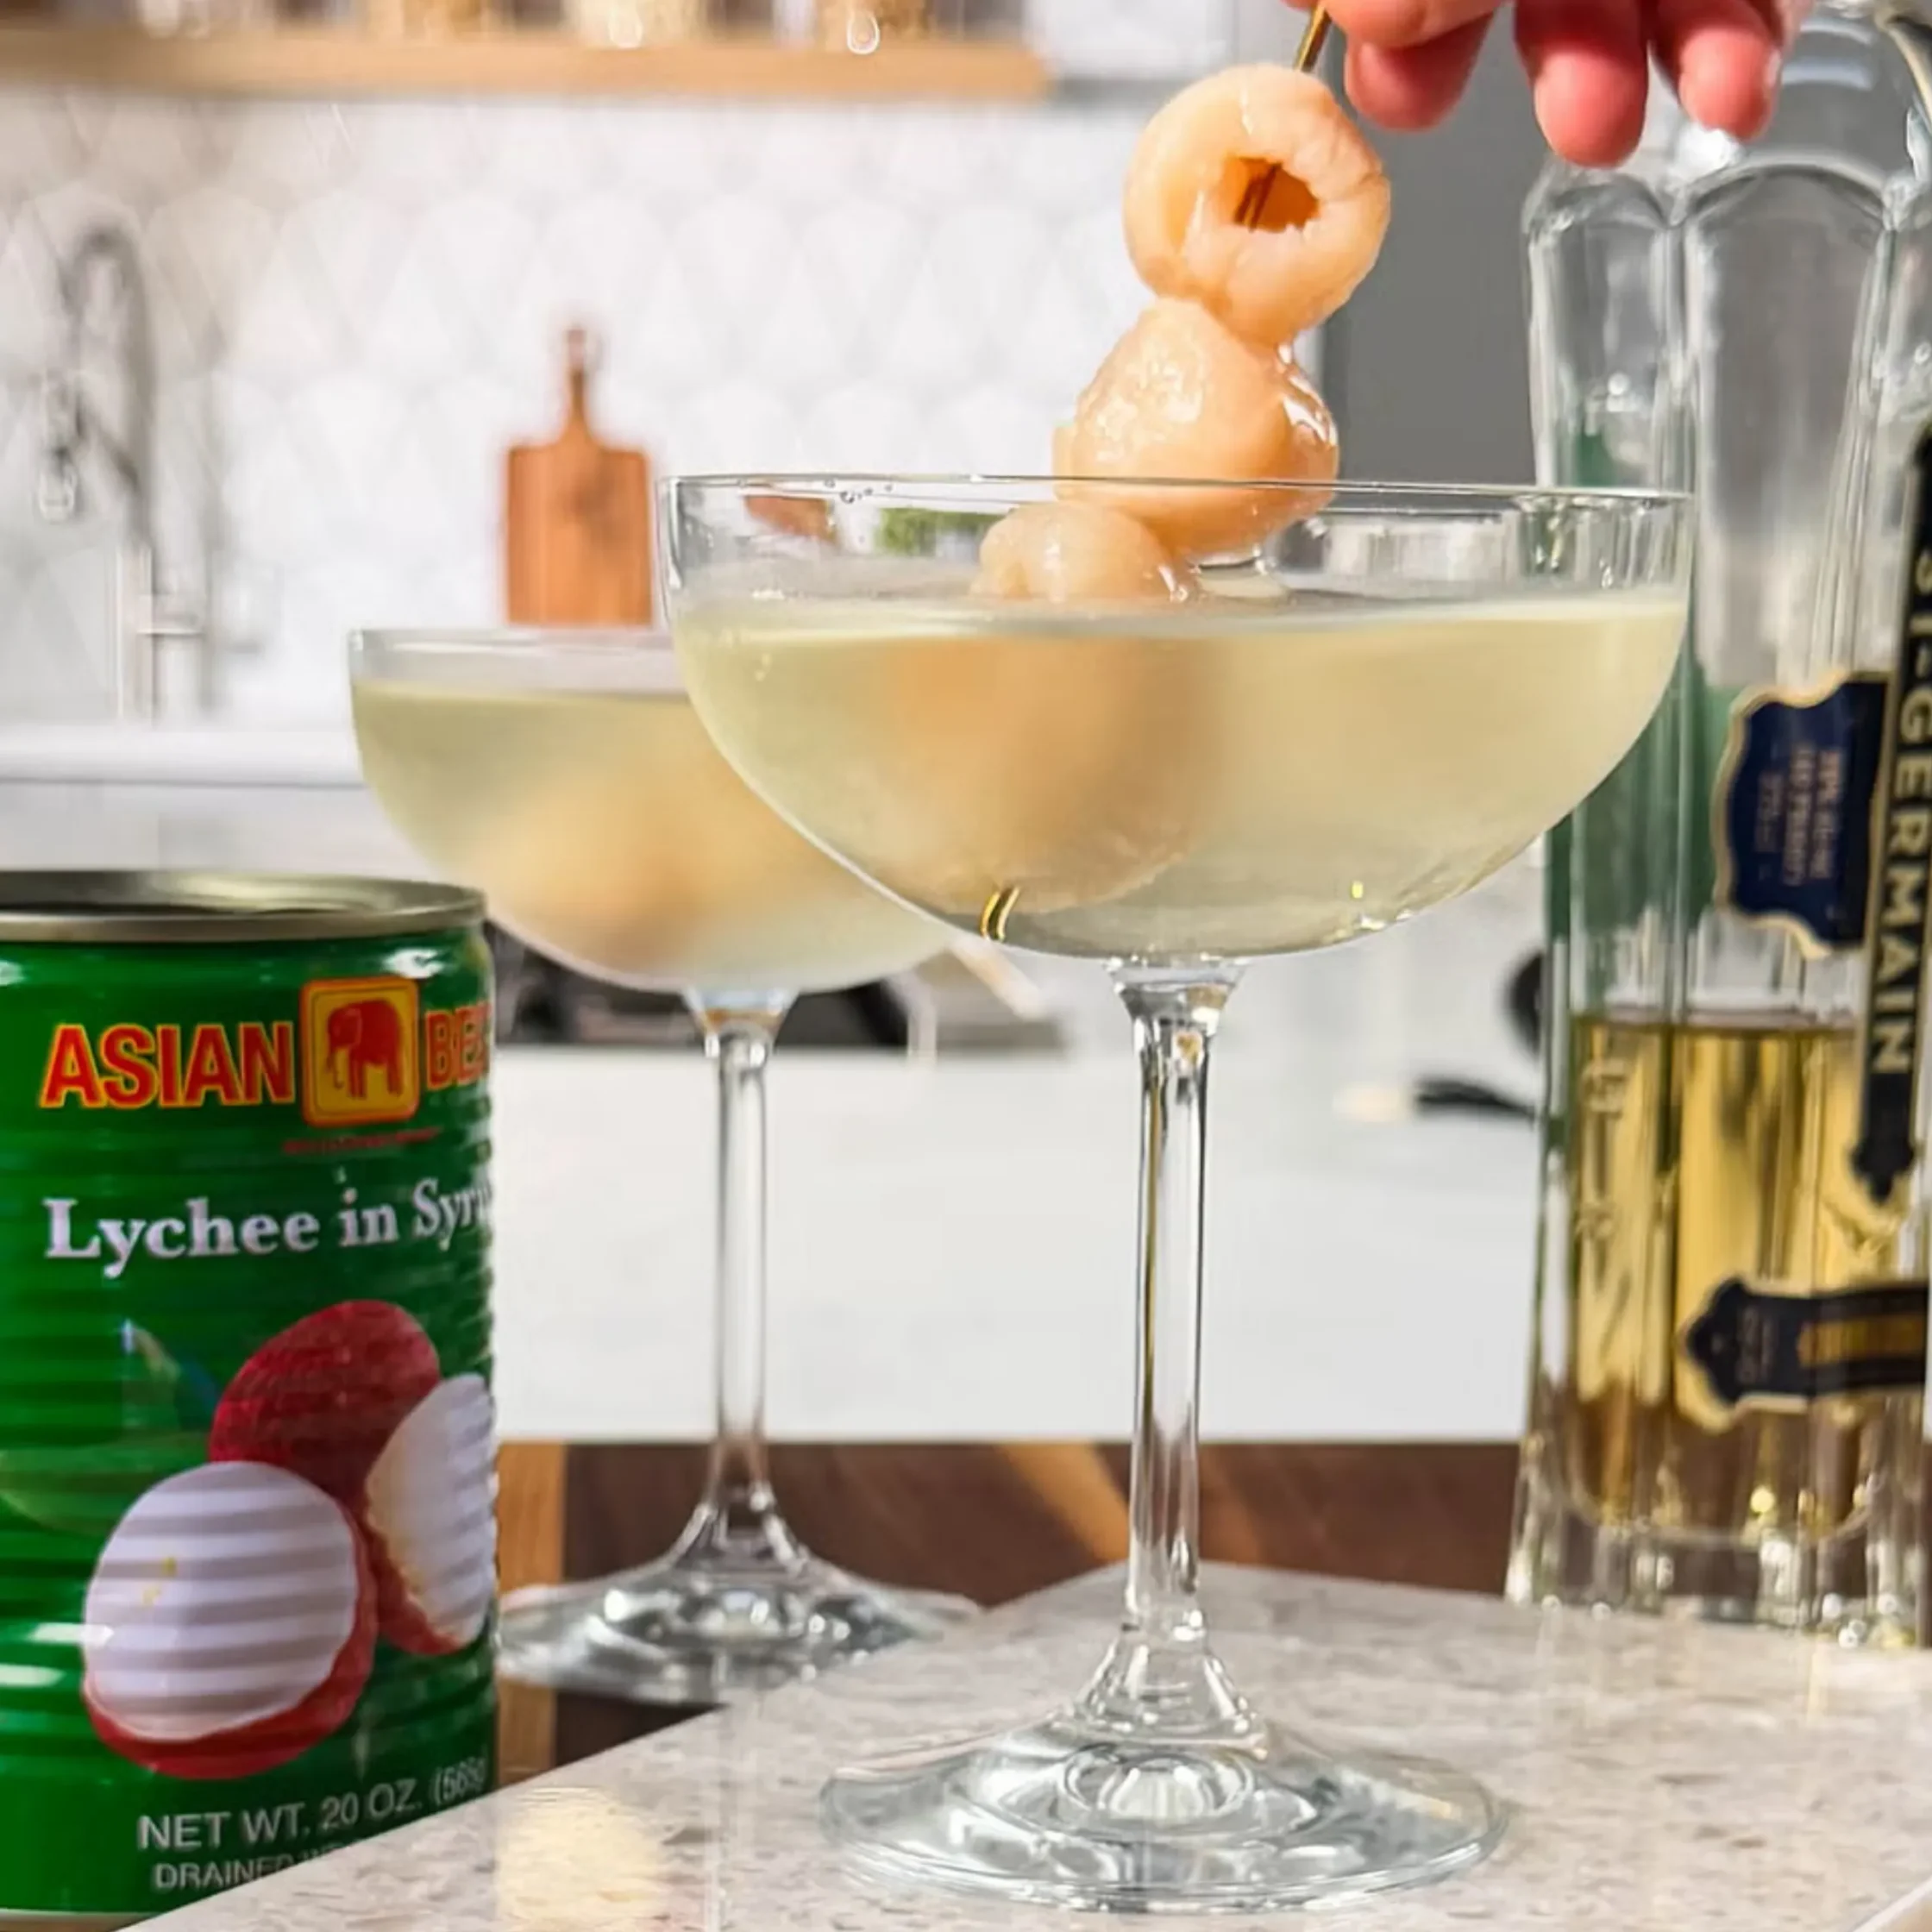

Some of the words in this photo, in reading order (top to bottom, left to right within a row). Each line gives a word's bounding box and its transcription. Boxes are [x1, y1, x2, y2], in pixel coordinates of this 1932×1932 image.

[40, 1021, 295, 1108] ASIAN
[43, 1196, 320, 1279] Lychee
[338, 1188, 398, 1247] in
[138, 1813, 231, 1849] NET
[242, 1803, 310, 1844] WT.
[321, 1793, 359, 1831] 20
[368, 1778, 423, 1816] OZ.
